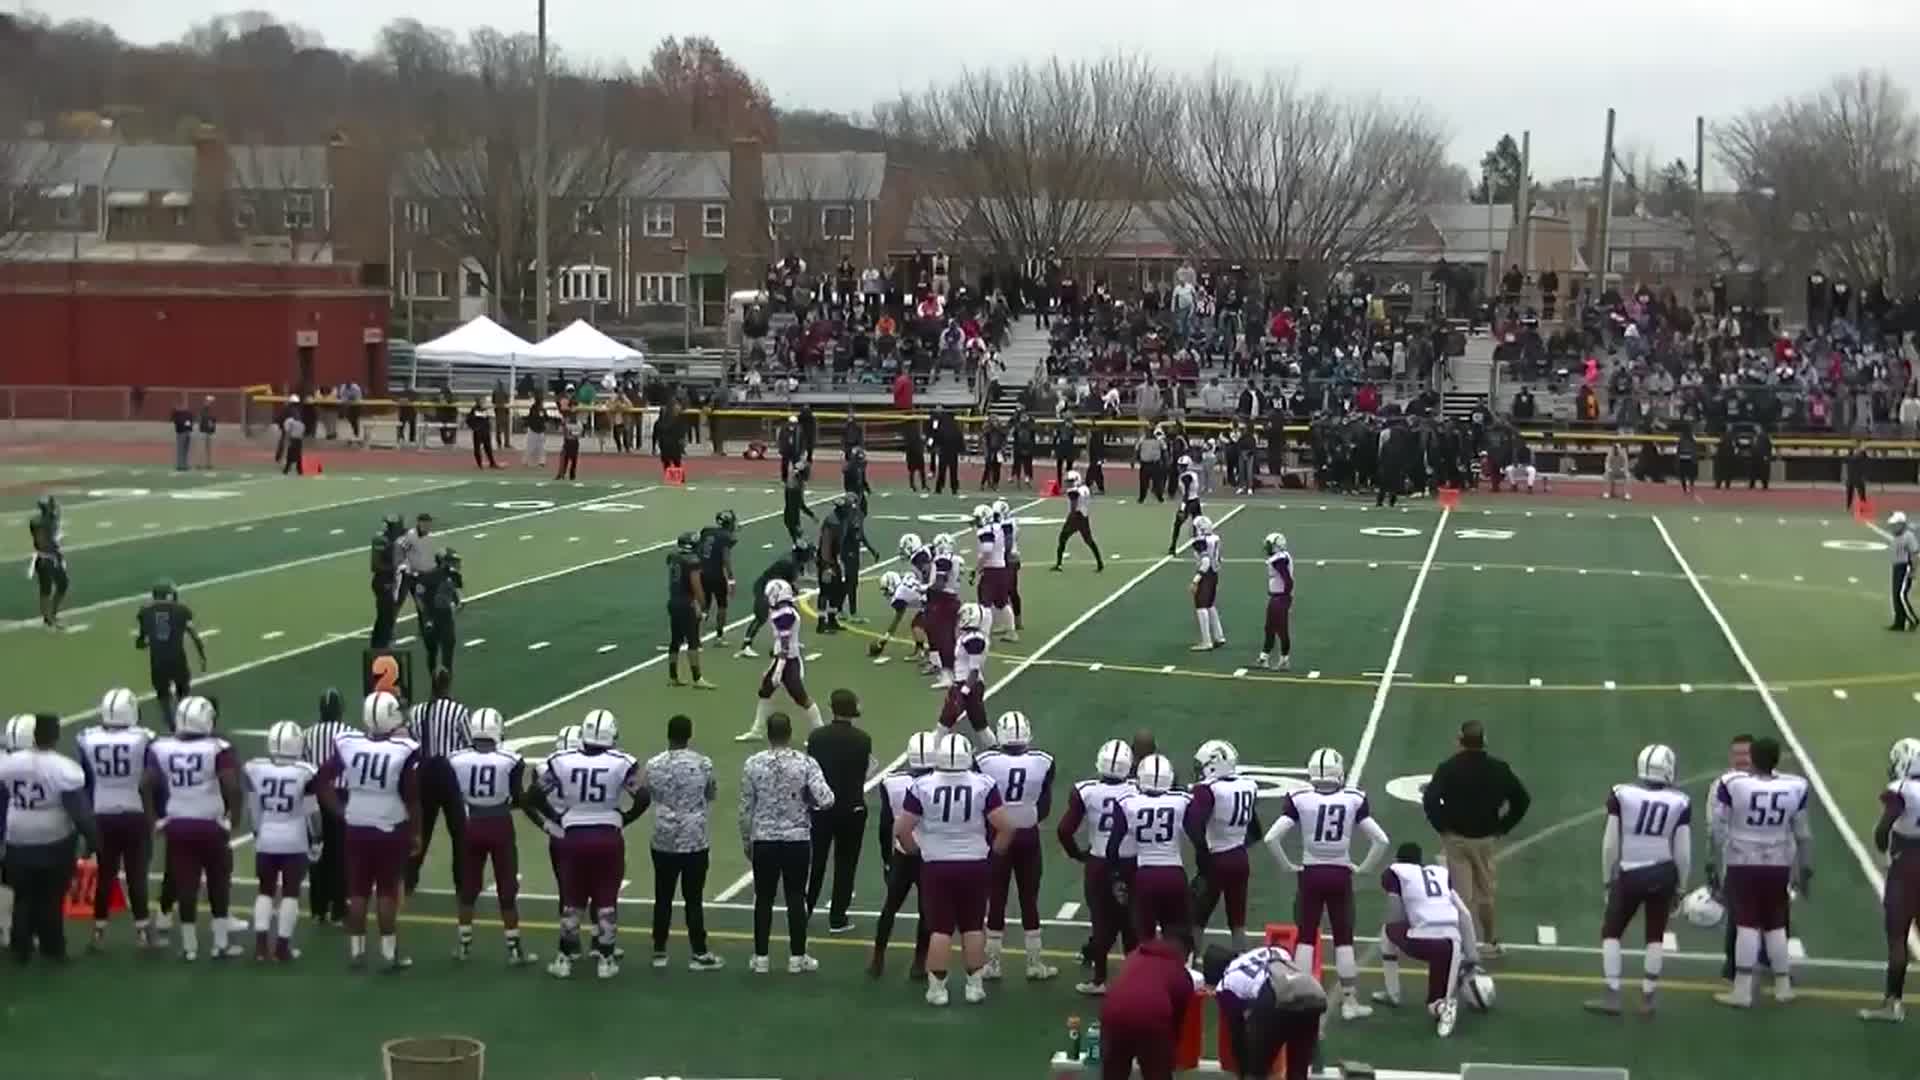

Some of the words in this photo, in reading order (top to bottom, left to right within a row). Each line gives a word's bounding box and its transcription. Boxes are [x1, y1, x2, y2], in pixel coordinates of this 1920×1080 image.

[372, 655, 399, 692] 2
[95, 745, 130, 777] 56
[169, 754, 204, 786] 52
[352, 753, 391, 788] 74
[261, 778, 294, 812] 25
[470, 765, 496, 797] 19
[571, 768, 609, 801] 75
[1005, 768, 1026, 801] 8
[933, 786, 972, 822] 77
[1229, 791, 1252, 826] 18
[1634, 801, 1667, 836] 10
[1747, 791, 1786, 826] 55
[1136, 807, 1174, 842] 23
[1313, 804, 1346, 841] 13
[1423, 866, 1441, 898] 6
